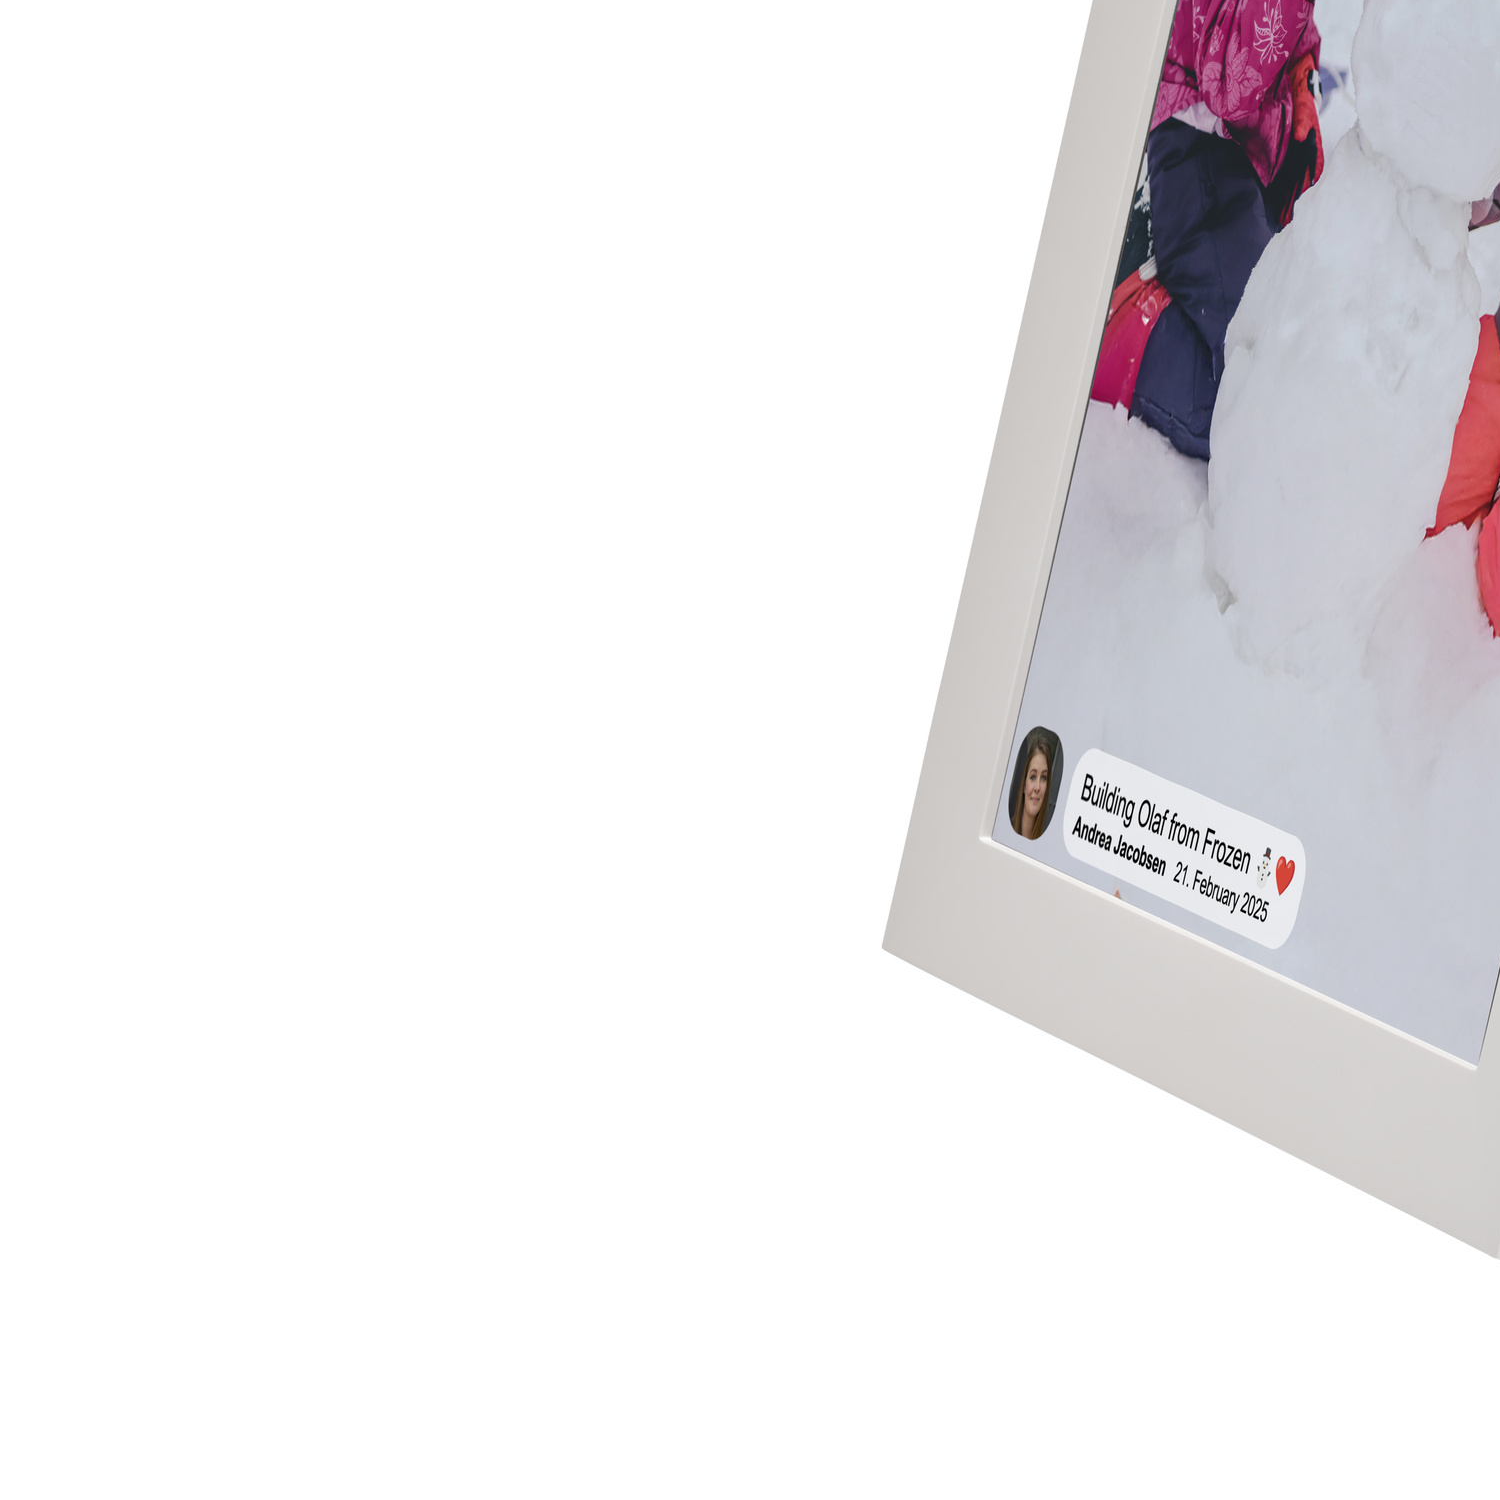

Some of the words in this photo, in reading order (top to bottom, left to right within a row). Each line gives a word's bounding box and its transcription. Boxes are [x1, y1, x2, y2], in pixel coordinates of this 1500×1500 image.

[1071, 815, 1112, 852] Andrea
[1113, 834, 1167, 877] Jacobsen
[1172, 861, 1190, 888] 21.
[1191, 869, 1240, 914] February
[1239, 891, 1270, 923] 2025
[1080, 773, 1136, 828] Building
[1137, 799, 1169, 836] Olaf
[1167, 812, 1200, 852] from
[1202, 827, 1251, 875] Frozen
